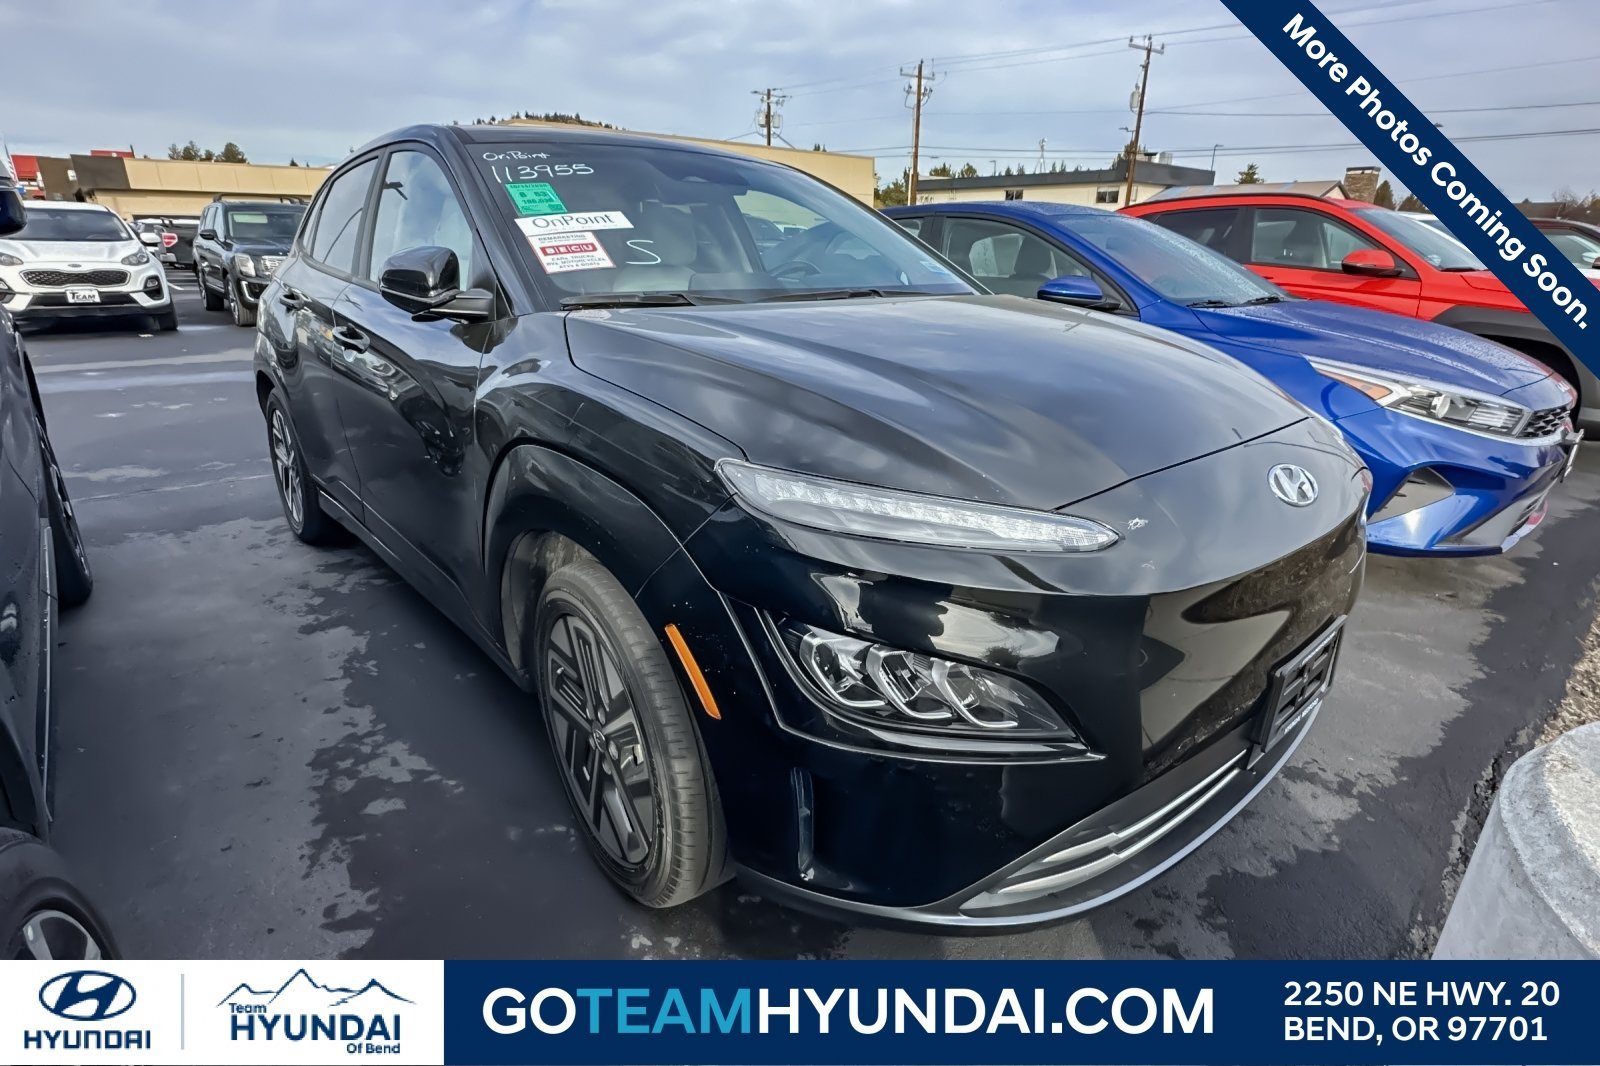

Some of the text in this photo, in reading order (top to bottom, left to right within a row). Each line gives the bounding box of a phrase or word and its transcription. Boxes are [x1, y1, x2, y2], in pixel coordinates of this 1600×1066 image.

[491, 164, 594, 183] 113955
[532, 214, 616, 228] OnPoint
[626, 239, 661, 265] S
